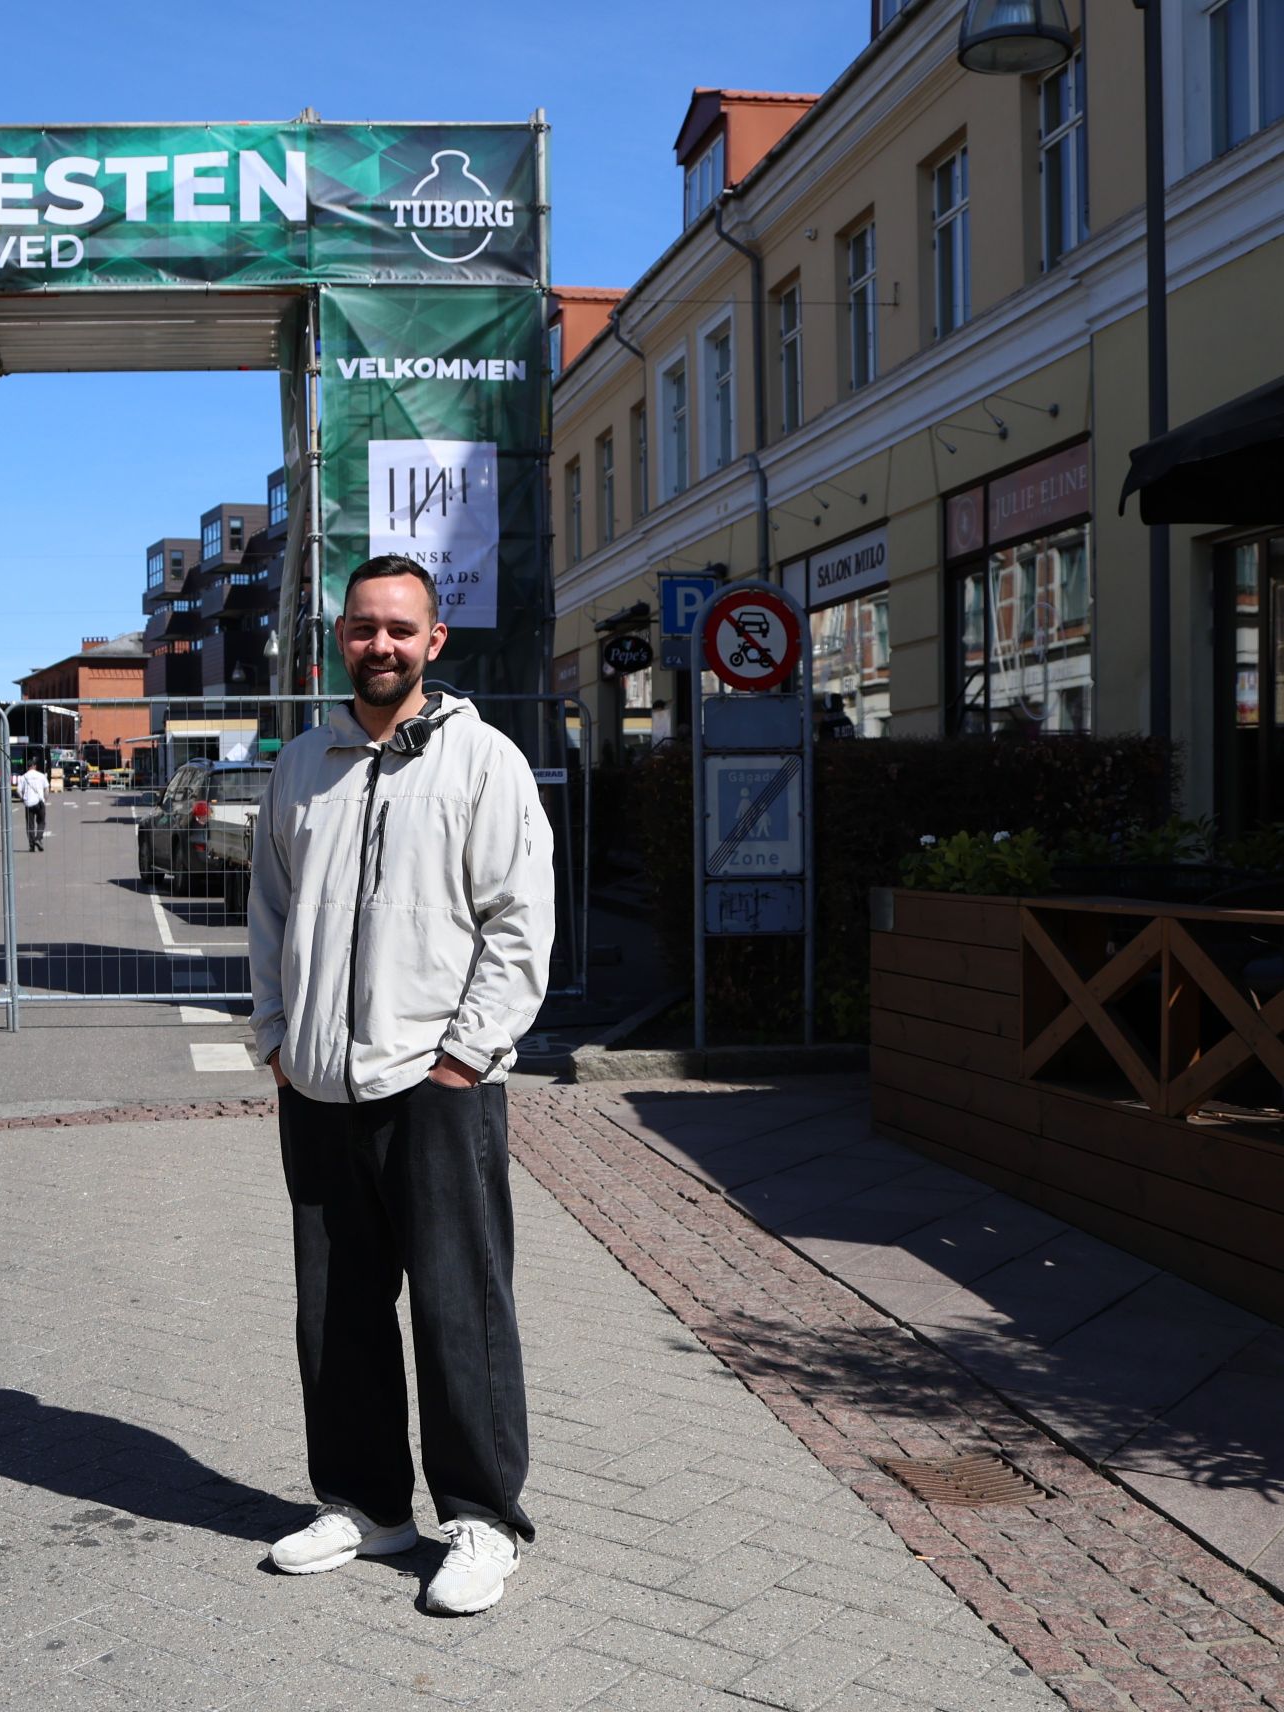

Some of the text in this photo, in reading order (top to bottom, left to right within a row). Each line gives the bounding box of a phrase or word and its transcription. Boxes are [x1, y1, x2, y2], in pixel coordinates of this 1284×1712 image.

[389, 199, 514, 228] TUBORG
[336, 357, 527, 382] VELKOMMEN
[992, 484, 1035, 530] JULIE
[1040, 464, 1088, 504] ELINE
[817, 542, 885, 588] SALON MILO
[675, 585, 705, 628] P
[609, 647, 649, 665] Pepe's
[533, 770, 564, 778] HERAS
[729, 850, 780, 866] Zone
